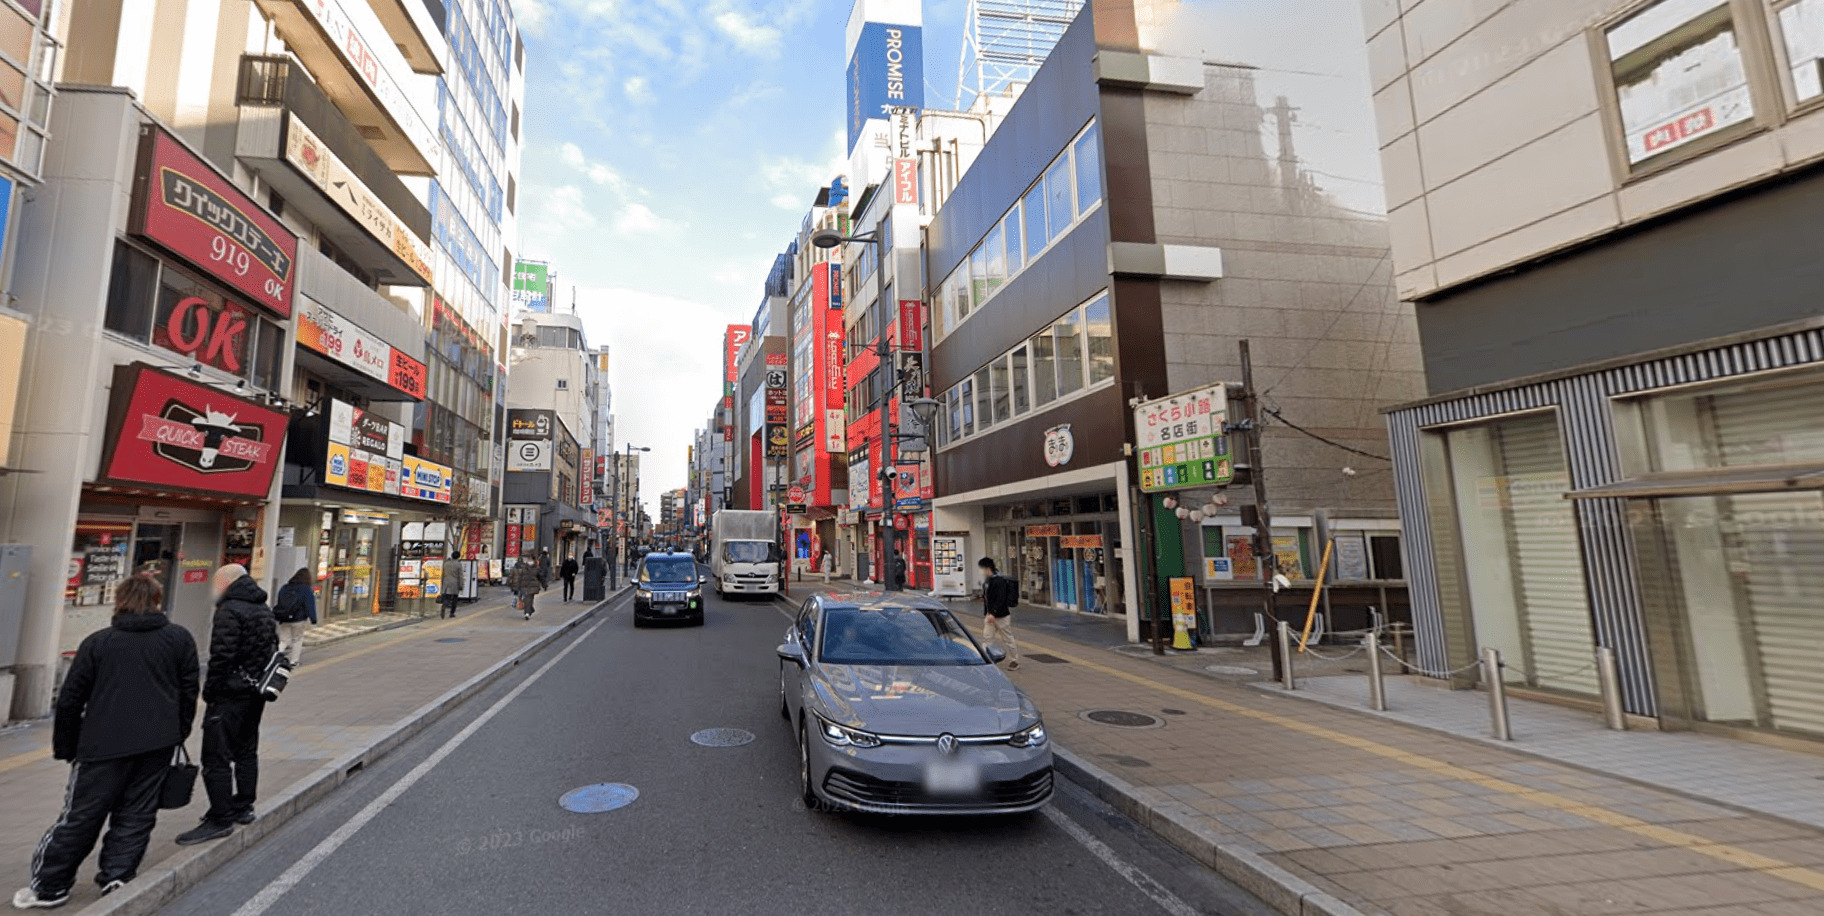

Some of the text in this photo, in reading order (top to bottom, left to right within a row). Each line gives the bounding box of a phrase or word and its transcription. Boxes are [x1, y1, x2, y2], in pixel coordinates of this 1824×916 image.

[886, 28, 904, 100] PROMISE
[900, 161, 913, 202] アイフル
[174, 179, 286, 273] クイックステーキ
[209, 235, 251, 276] 919
[264, 278, 285, 301] OK
[168, 296, 246, 371] OK
[395, 354, 420, 376] 生ビール
[513, 419, 535, 428] ドトール
[1147, 397, 1211, 427] さくら小路
[156, 425, 262, 458] QUICK STEAK
[1160, 420, 1198, 441] 名店街
[417, 472, 440, 484] MINI STOP
[582, 459, 593, 504] サンドラッグ
